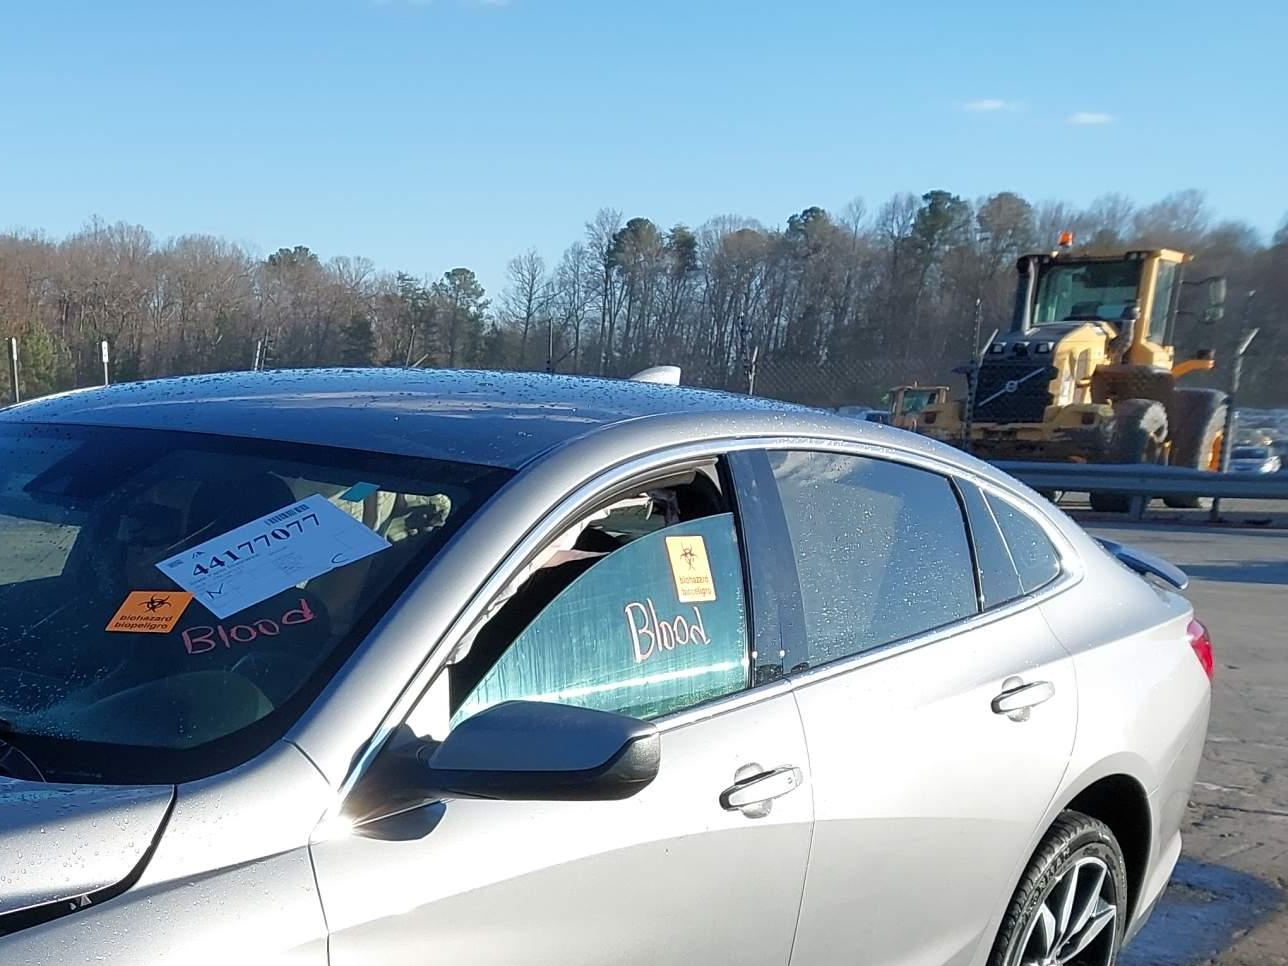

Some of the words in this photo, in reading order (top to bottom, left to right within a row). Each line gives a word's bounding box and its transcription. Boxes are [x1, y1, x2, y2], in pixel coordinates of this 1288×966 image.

[192, 513, 320, 577] 44177077
[114, 622, 168, 630] biopeligro
[181, 598, 315, 655] Blood
[624, 597, 711, 663] Blood
